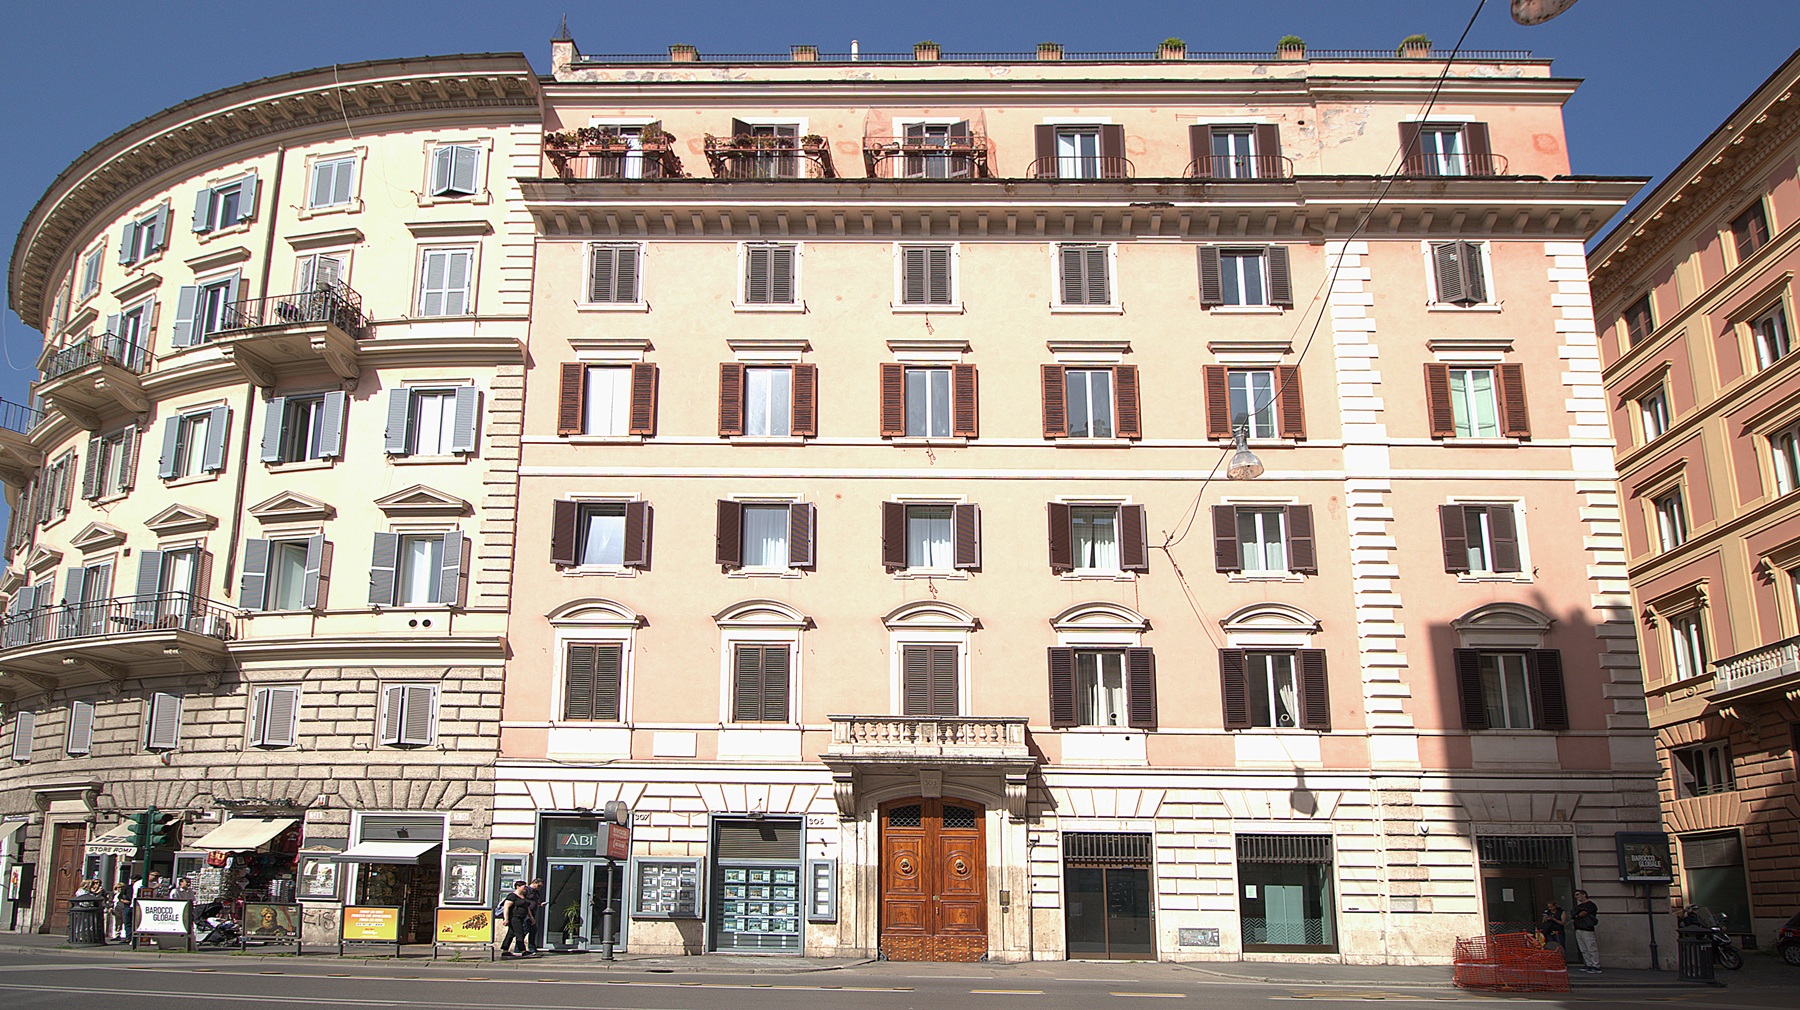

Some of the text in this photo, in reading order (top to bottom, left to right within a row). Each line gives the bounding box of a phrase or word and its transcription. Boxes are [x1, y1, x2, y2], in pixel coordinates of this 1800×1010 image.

[634, 813, 650, 821] 307
[1638, 860, 1662, 868] GLOBALE
[145, 906, 173, 915] BAROCCO
[153, 914, 180, 922] GLOBALE
